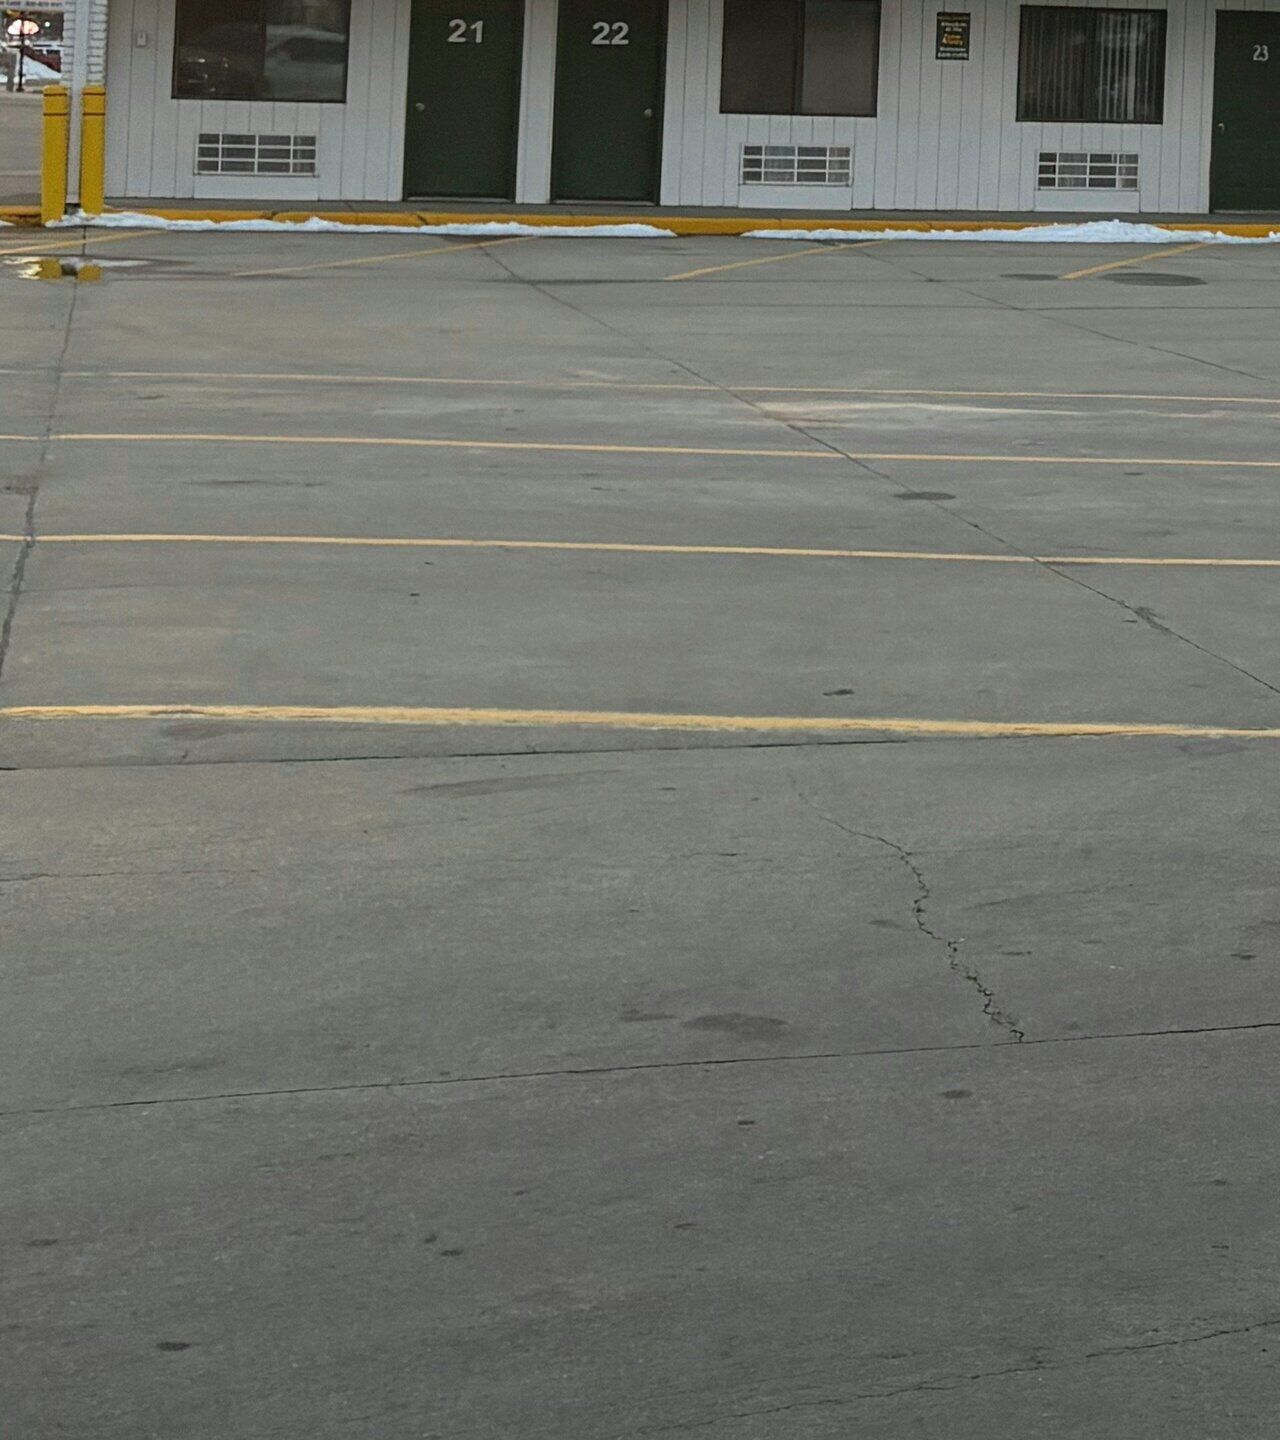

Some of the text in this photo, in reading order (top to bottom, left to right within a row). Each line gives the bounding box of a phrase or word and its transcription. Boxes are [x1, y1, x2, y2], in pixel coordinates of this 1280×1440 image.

[448, 18, 484, 44] 21
[591, 21, 629, 45] 22
[1252, 44, 1269, 62] 23
